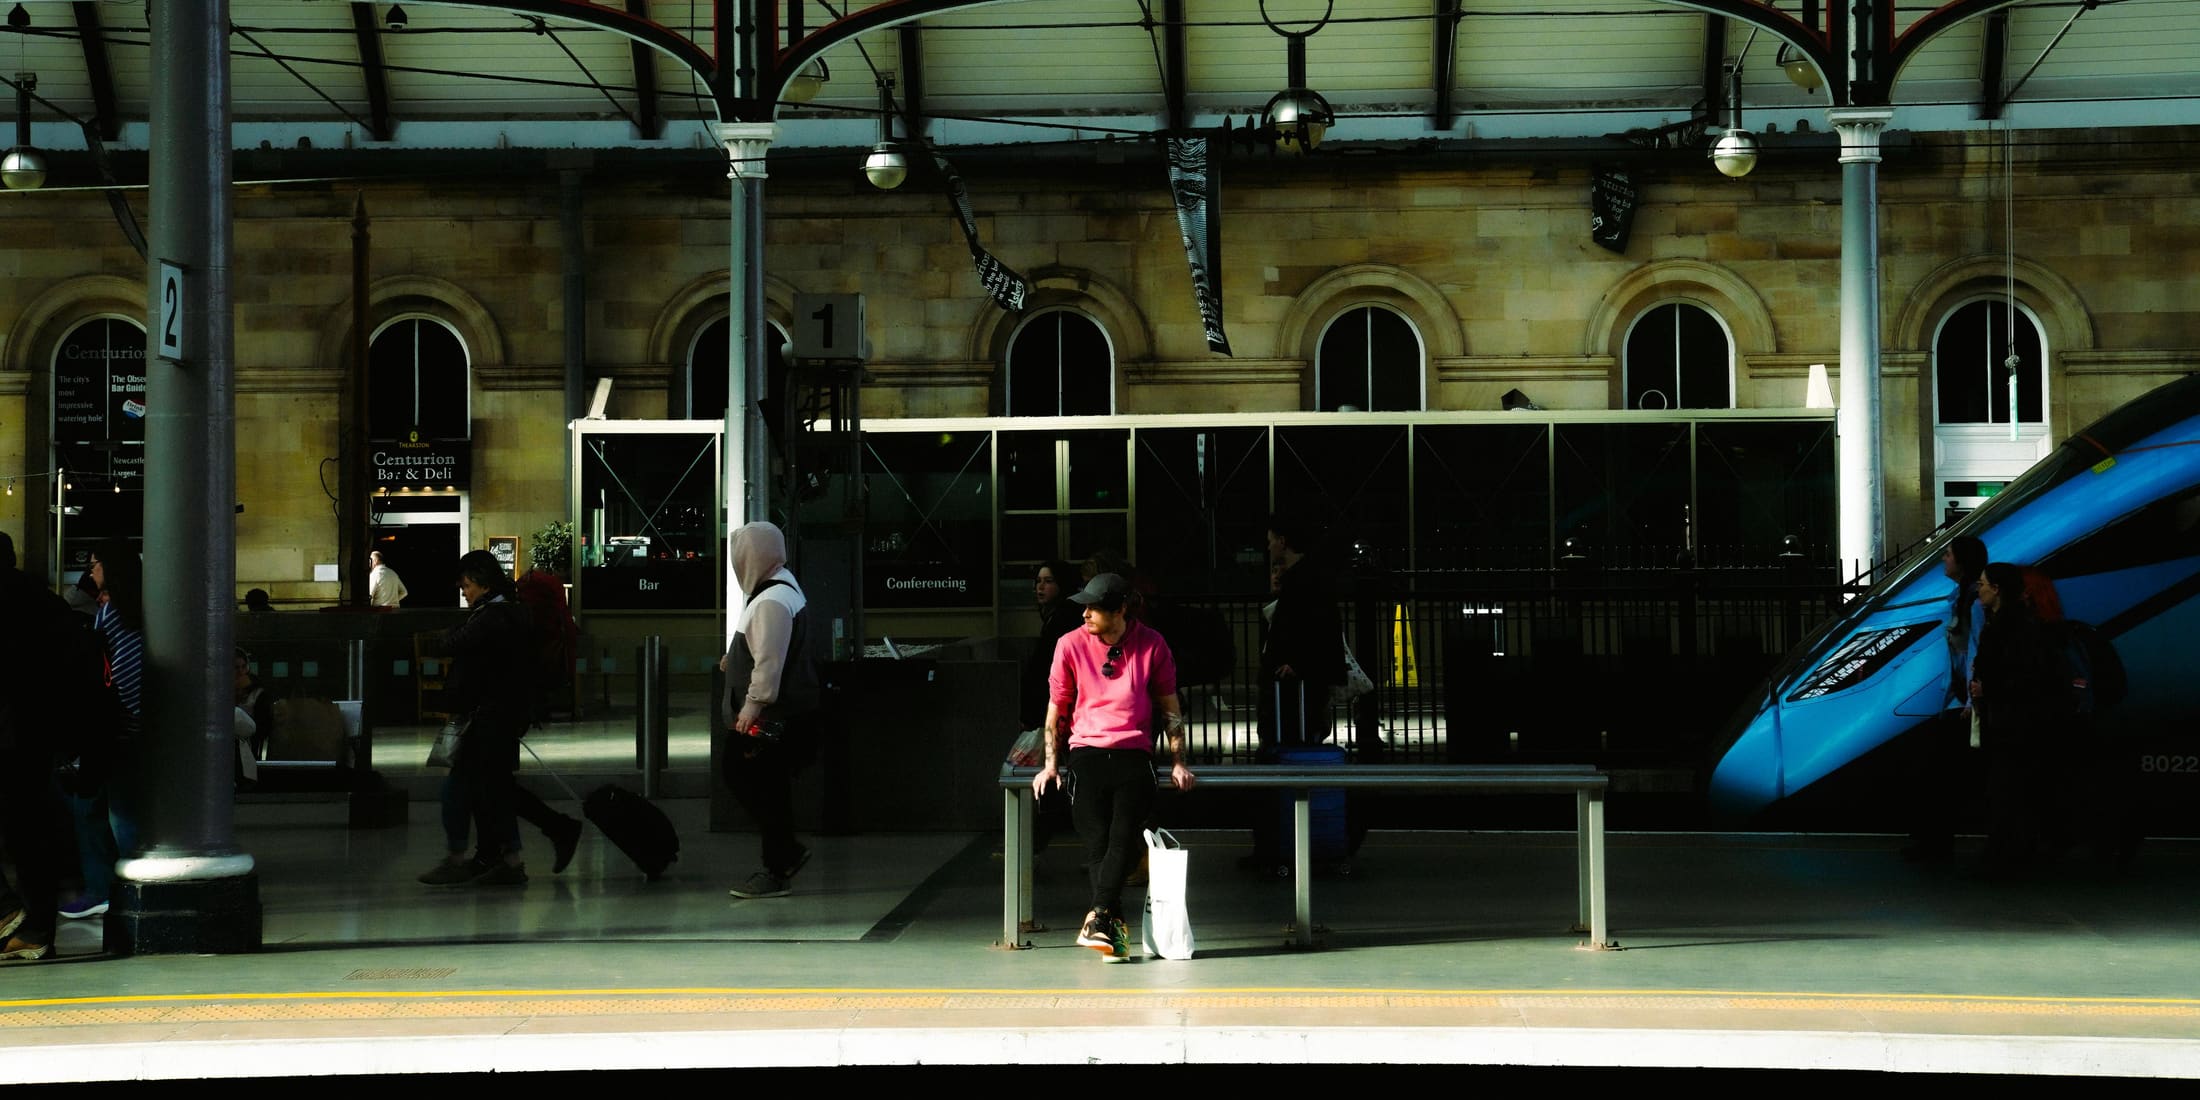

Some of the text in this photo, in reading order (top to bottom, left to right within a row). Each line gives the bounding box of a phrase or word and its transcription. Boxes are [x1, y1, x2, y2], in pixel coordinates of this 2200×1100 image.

[165, 276, 177, 347] 2
[812, 303, 833, 348] 1
[111, 374, 126, 383] The
[111, 384, 125, 393] Bar
[57, 401, 95, 410] impressive
[57, 415, 87, 424] watering
[373, 451, 456, 466] Centurion
[377, 466, 452, 480] Bar & Deli
[639, 578, 660, 591] Bar
[886, 576, 967, 592] Conferencing
[2141, 755, 2199, 772] 8022
